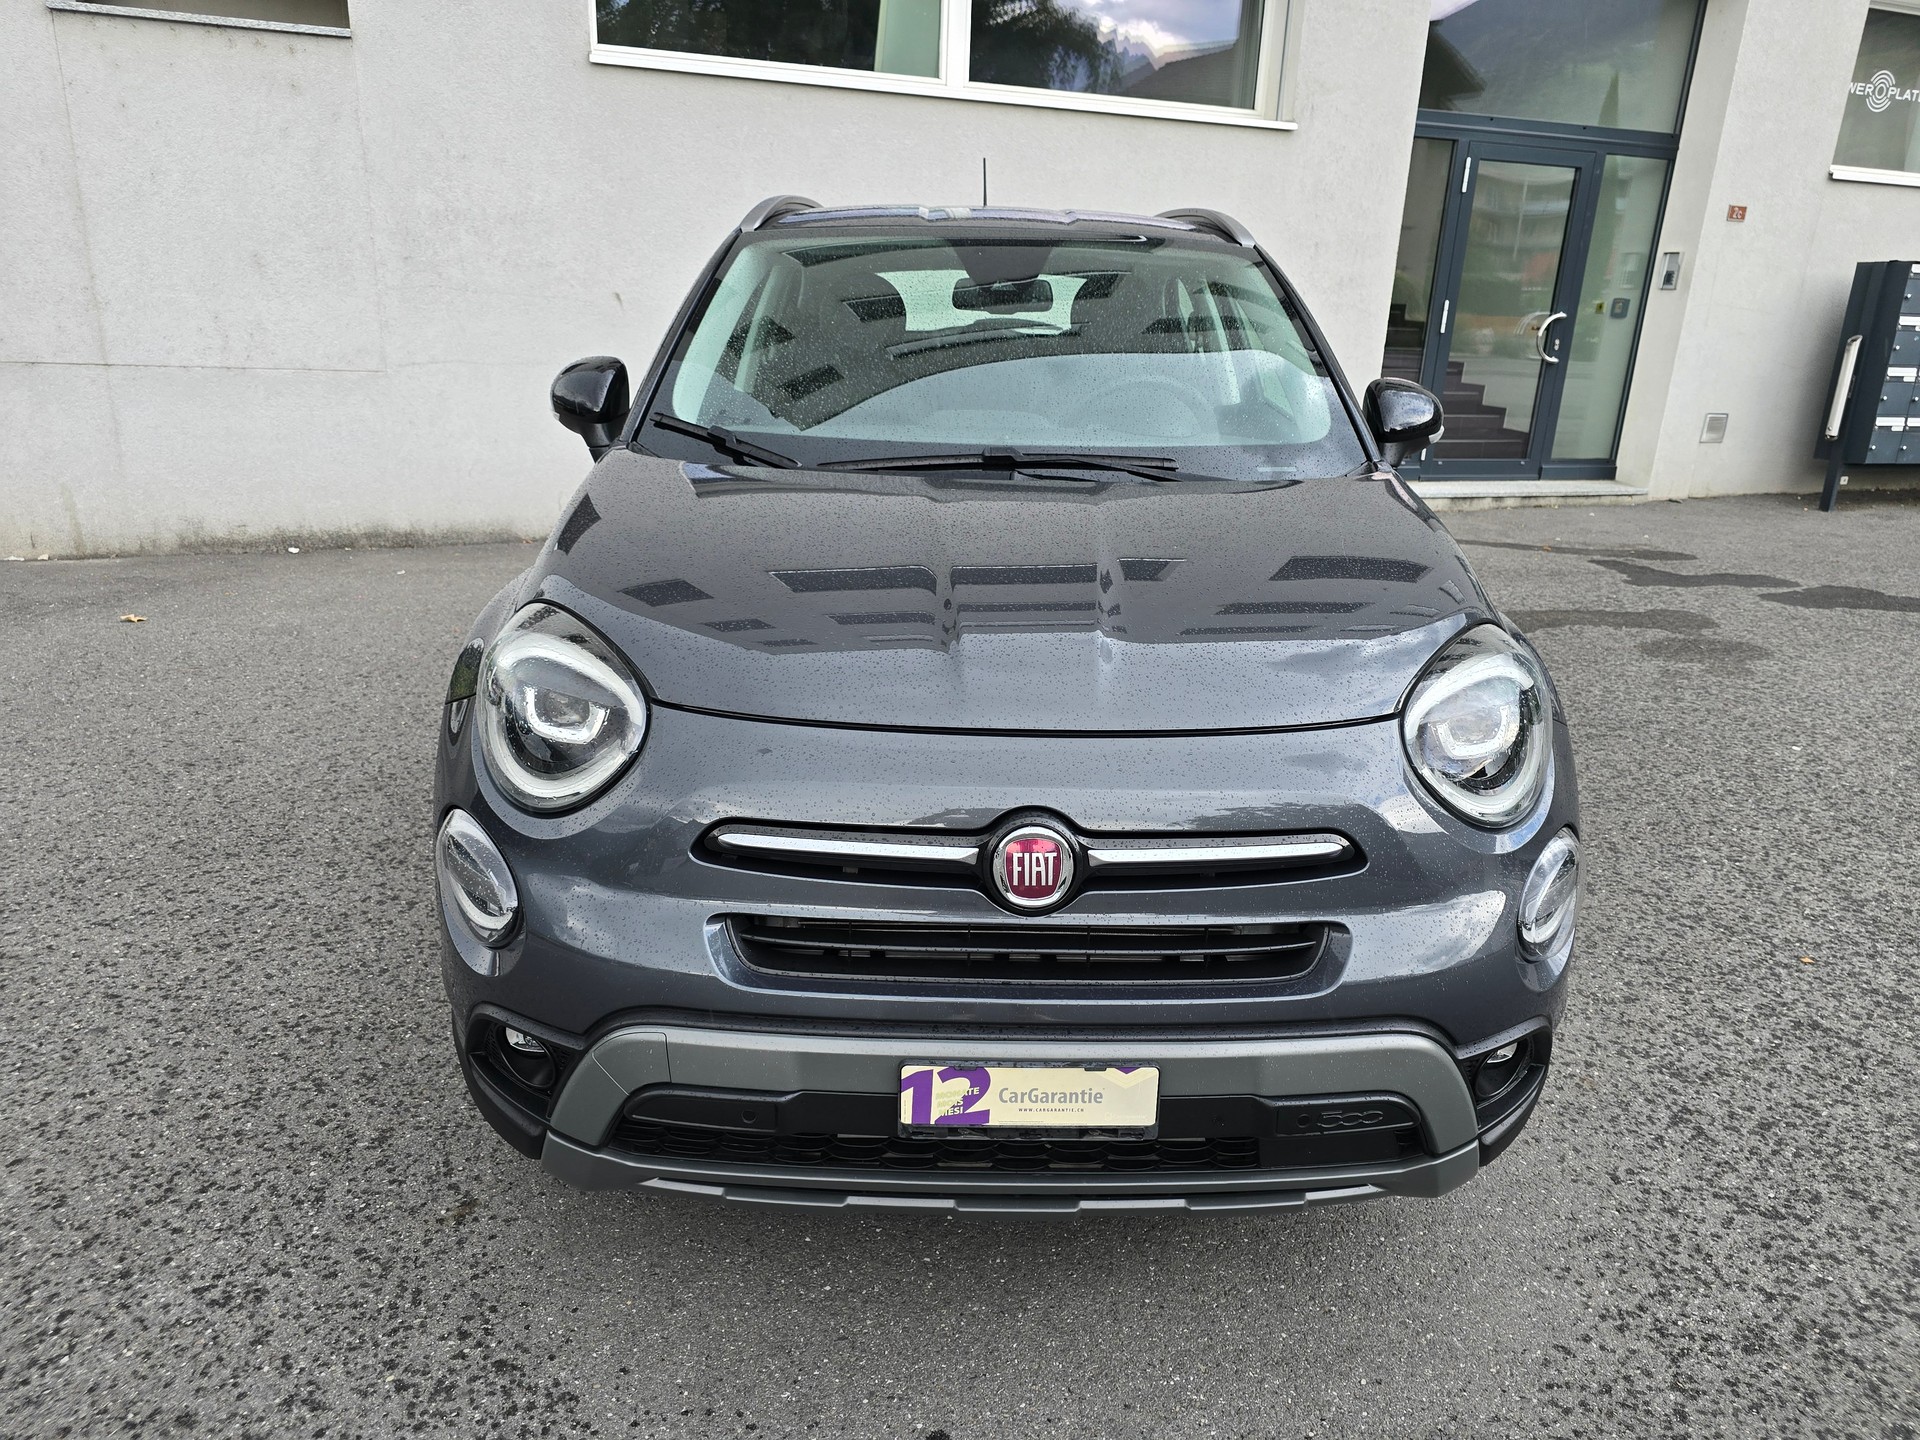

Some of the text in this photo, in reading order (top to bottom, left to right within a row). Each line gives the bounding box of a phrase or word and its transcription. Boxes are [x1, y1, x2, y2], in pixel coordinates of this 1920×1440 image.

[1887, 87, 1920, 102] PLAT
[1012, 852, 1057, 886] FIAT
[901, 1066, 991, 1125] 12
[998, 1088, 1103, 1103] CarGarantie
